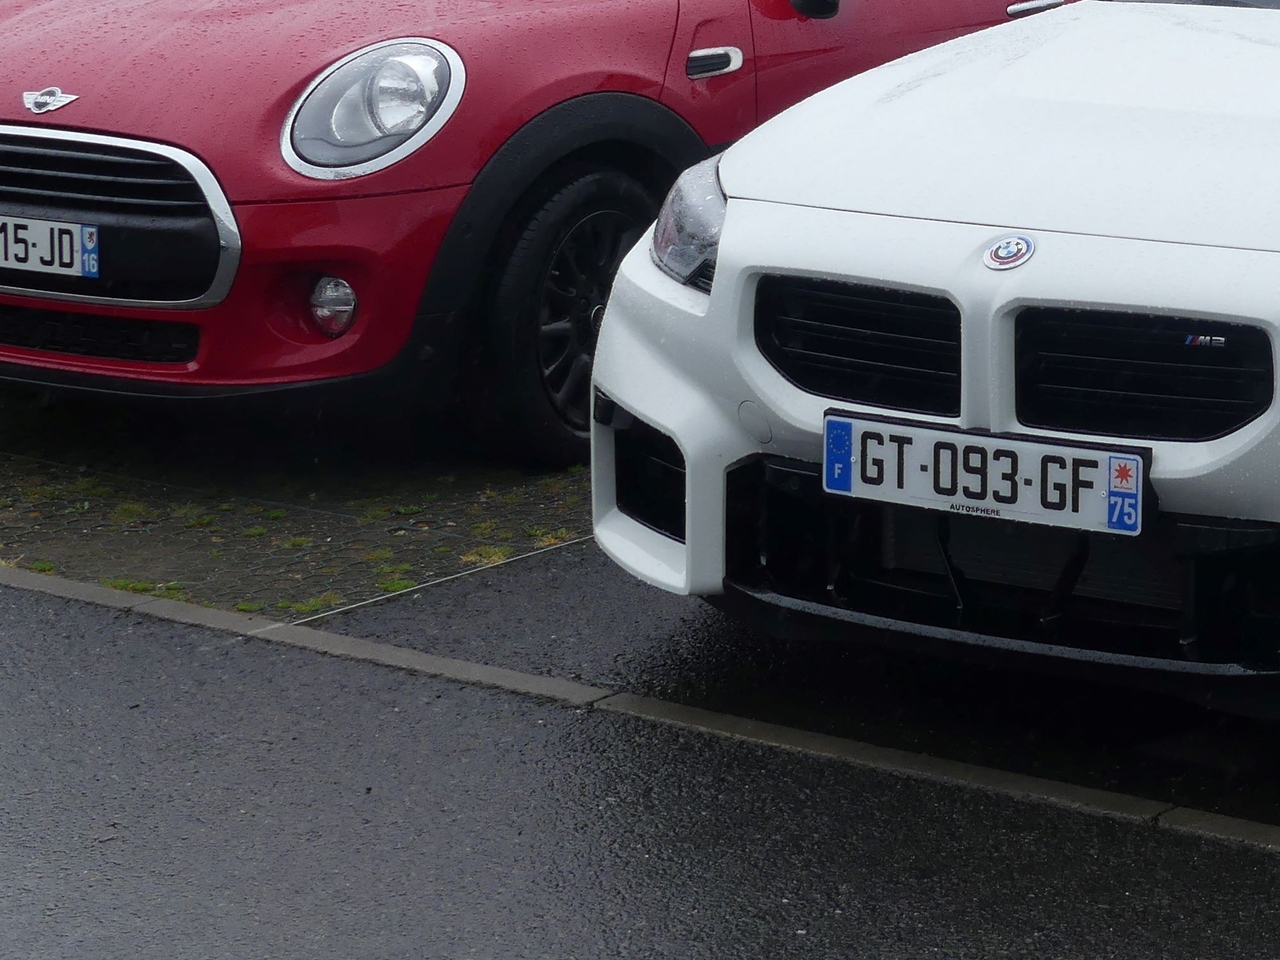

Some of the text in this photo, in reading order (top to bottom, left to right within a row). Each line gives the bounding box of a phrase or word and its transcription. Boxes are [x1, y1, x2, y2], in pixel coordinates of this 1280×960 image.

[82, 253, 98, 273] 16
[1197, 335, 1226, 347] M2
[834, 463, 843, 479] F
[860, 431, 1099, 513] GT-093-GF
[950, 503, 1001, 516] AUTOSPHERE
[1109, 496, 1137, 525] 75
